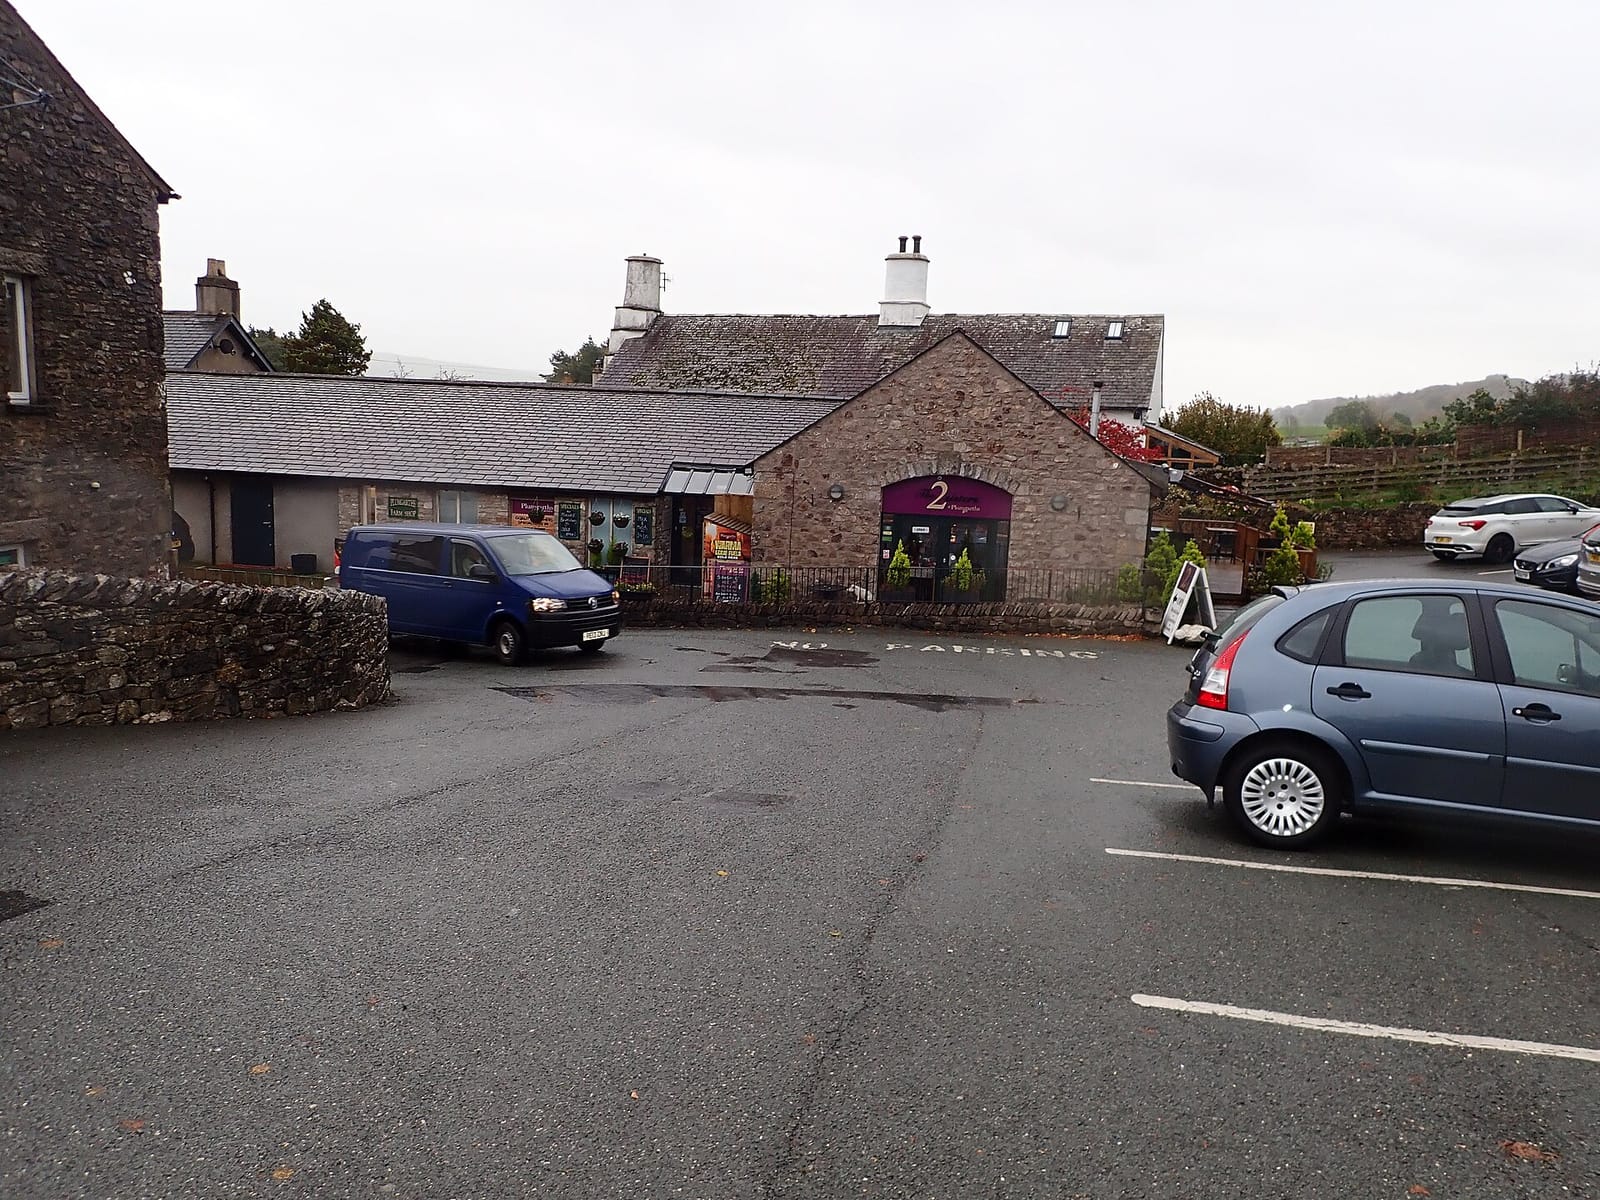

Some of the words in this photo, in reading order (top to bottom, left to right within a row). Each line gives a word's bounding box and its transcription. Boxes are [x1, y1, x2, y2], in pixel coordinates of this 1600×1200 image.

[926, 481, 948, 510] 2
[769, 641, 828, 650] NO
[885, 643, 1100, 659] PARKING
